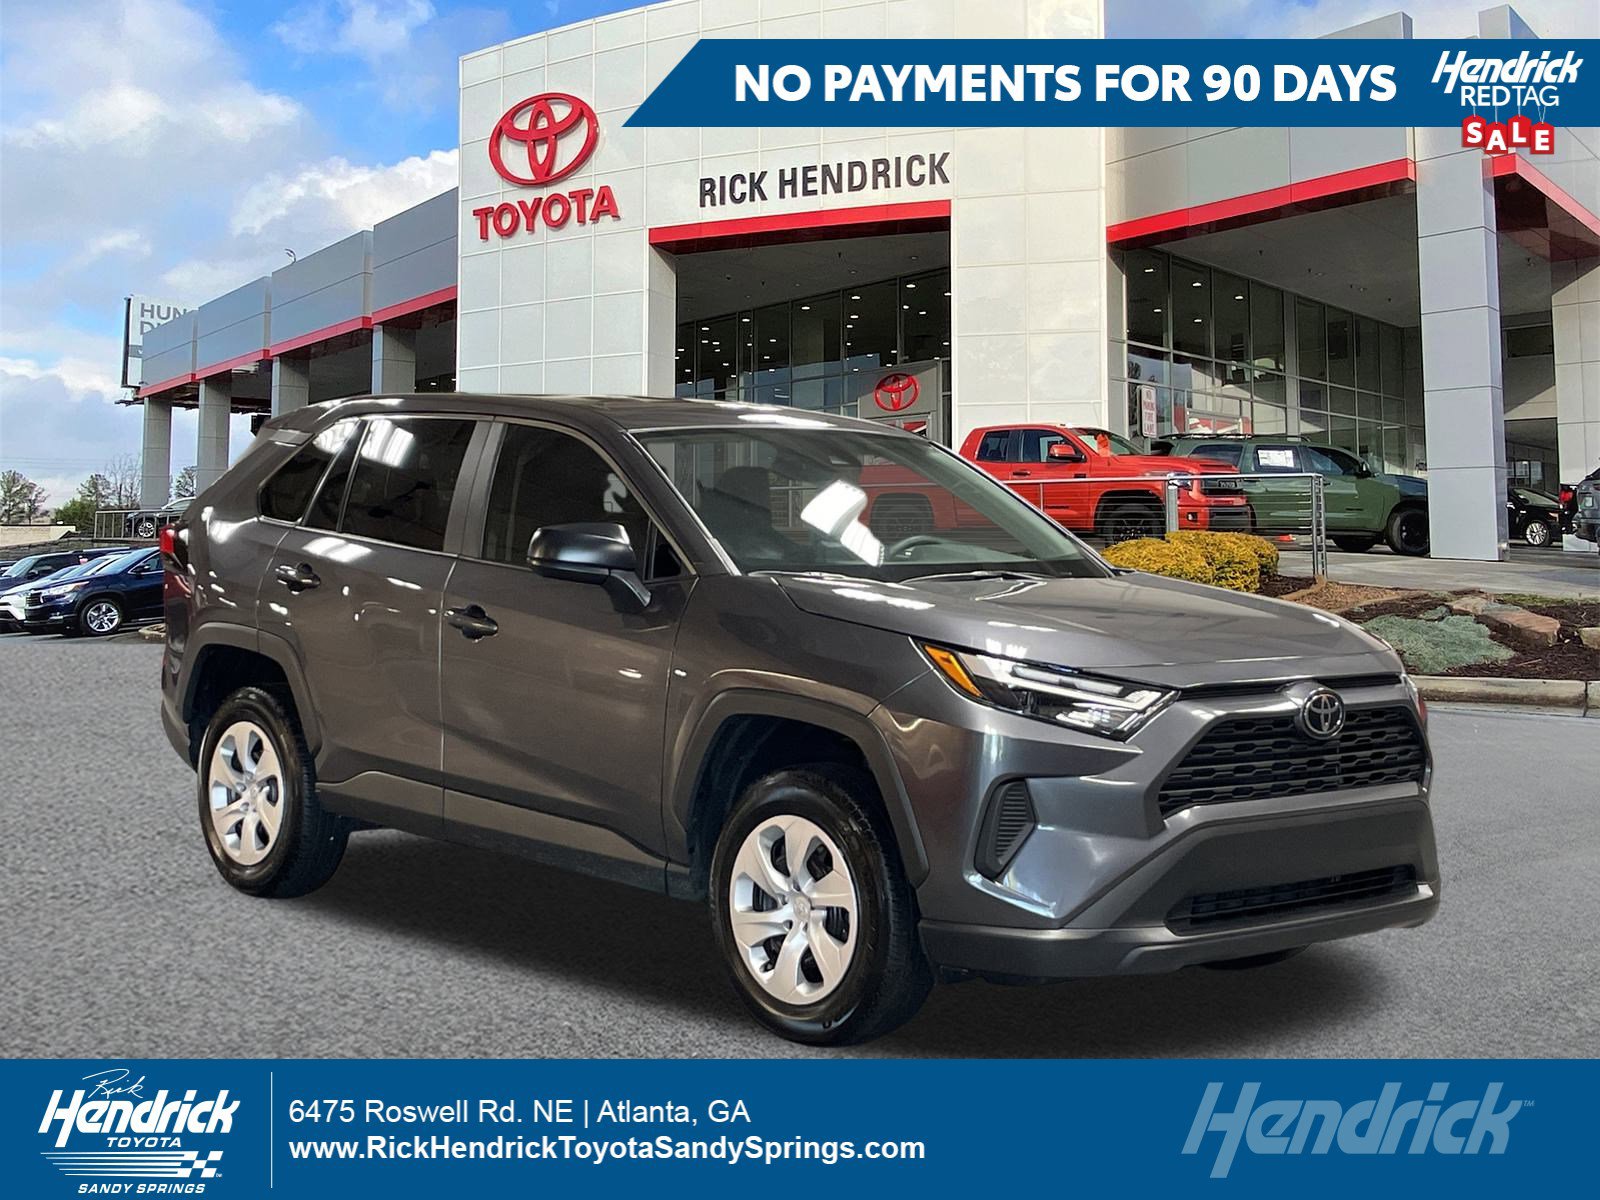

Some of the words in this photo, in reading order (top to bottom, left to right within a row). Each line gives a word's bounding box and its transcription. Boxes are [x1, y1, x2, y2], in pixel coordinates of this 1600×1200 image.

[699, 170, 768, 208] RICK
[778, 152, 950, 199] HENDRICK
[473, 185, 620, 241] TOYOTA
